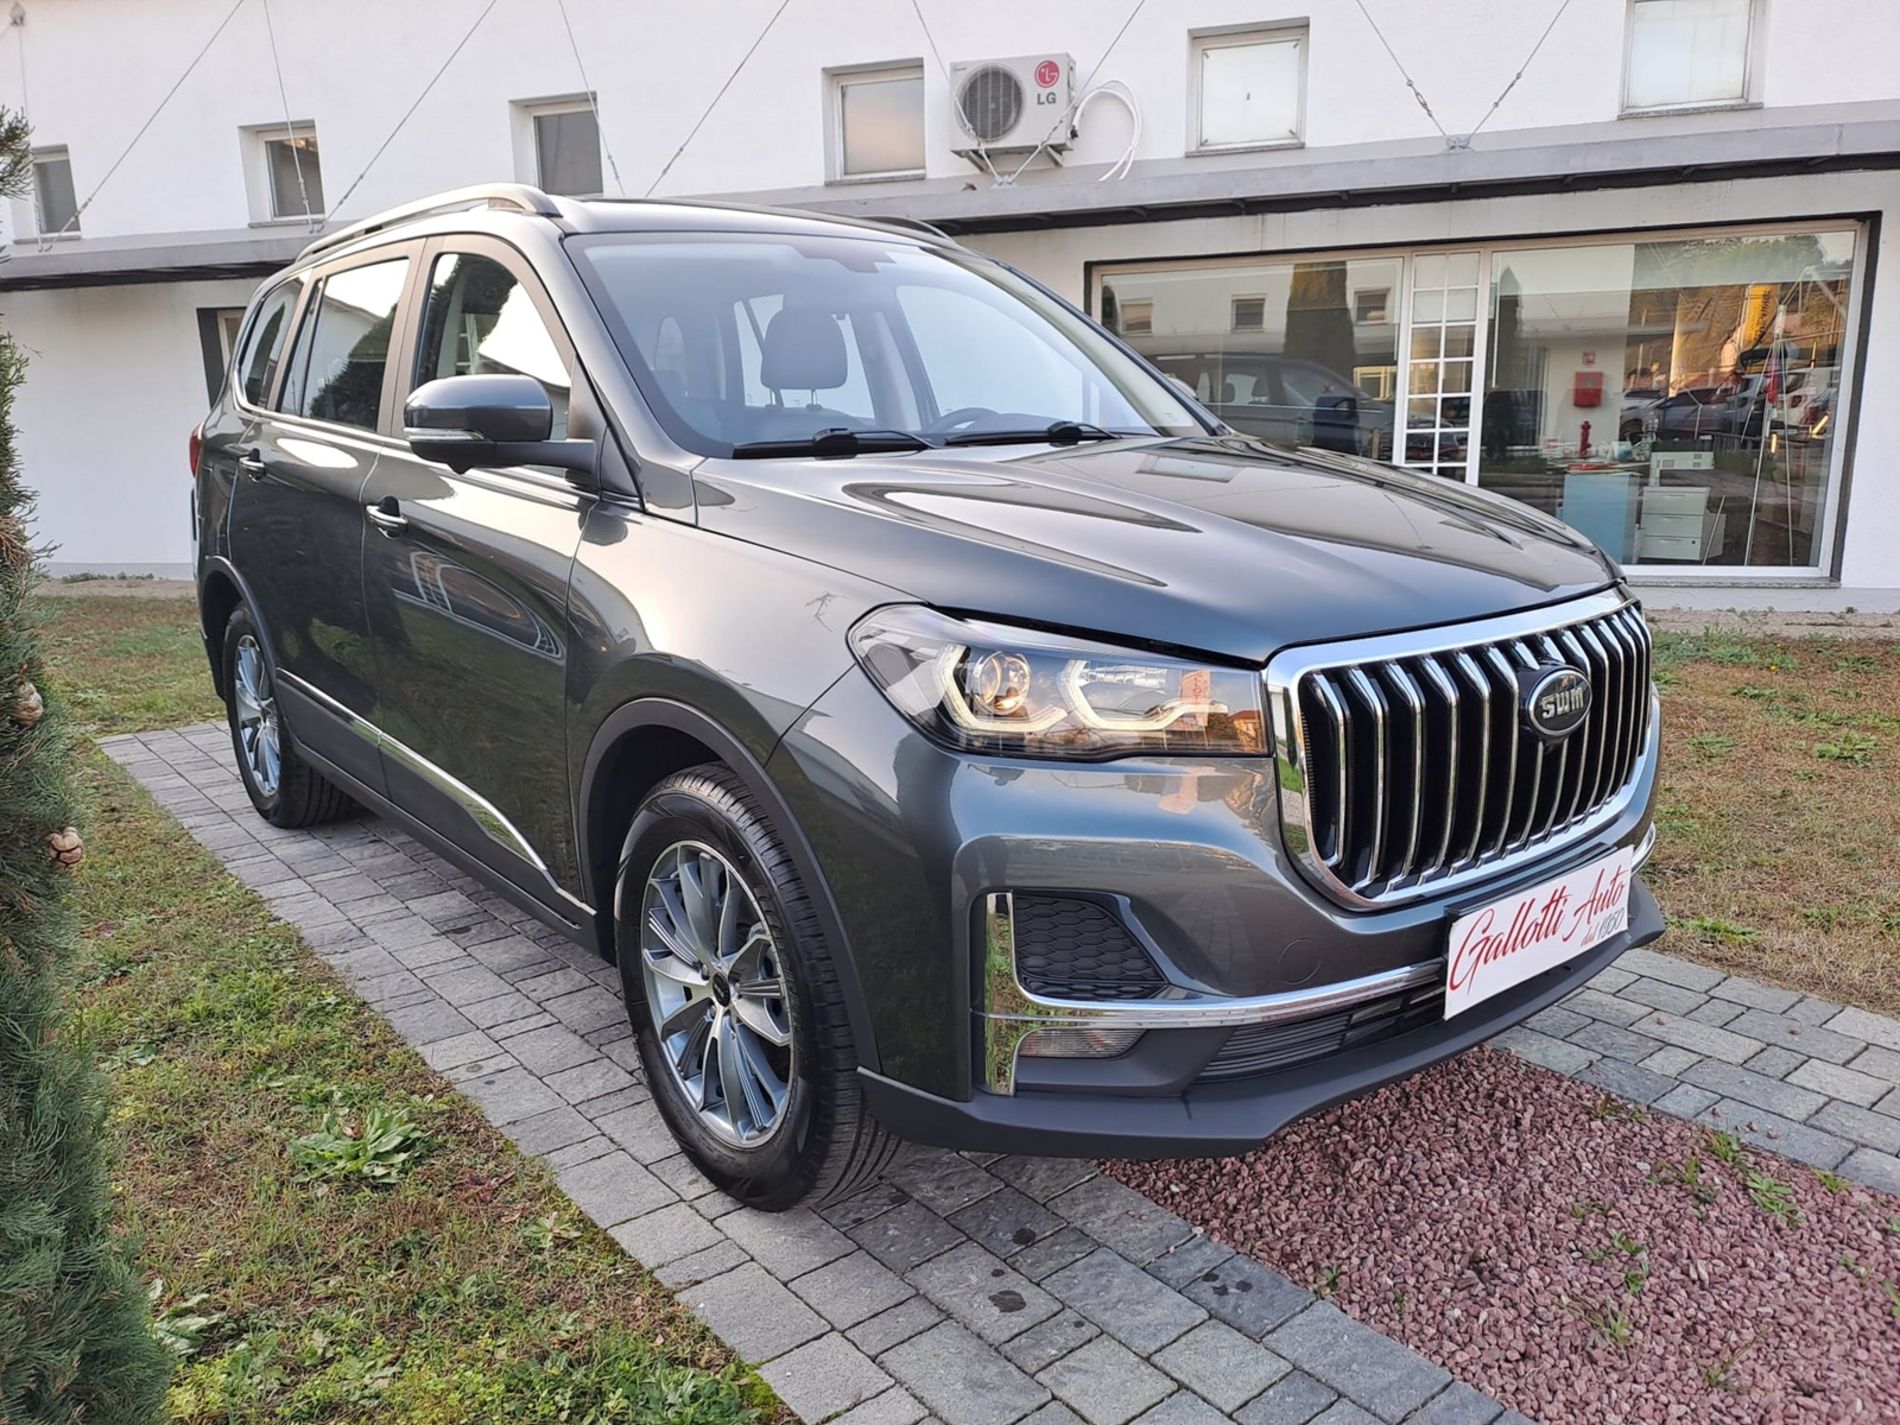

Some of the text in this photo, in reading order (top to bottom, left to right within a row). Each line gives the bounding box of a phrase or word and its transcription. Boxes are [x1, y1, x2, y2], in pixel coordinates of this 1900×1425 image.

[1037, 92, 1057, 105] LG
[1450, 865, 1629, 995] Gallotti Auto
